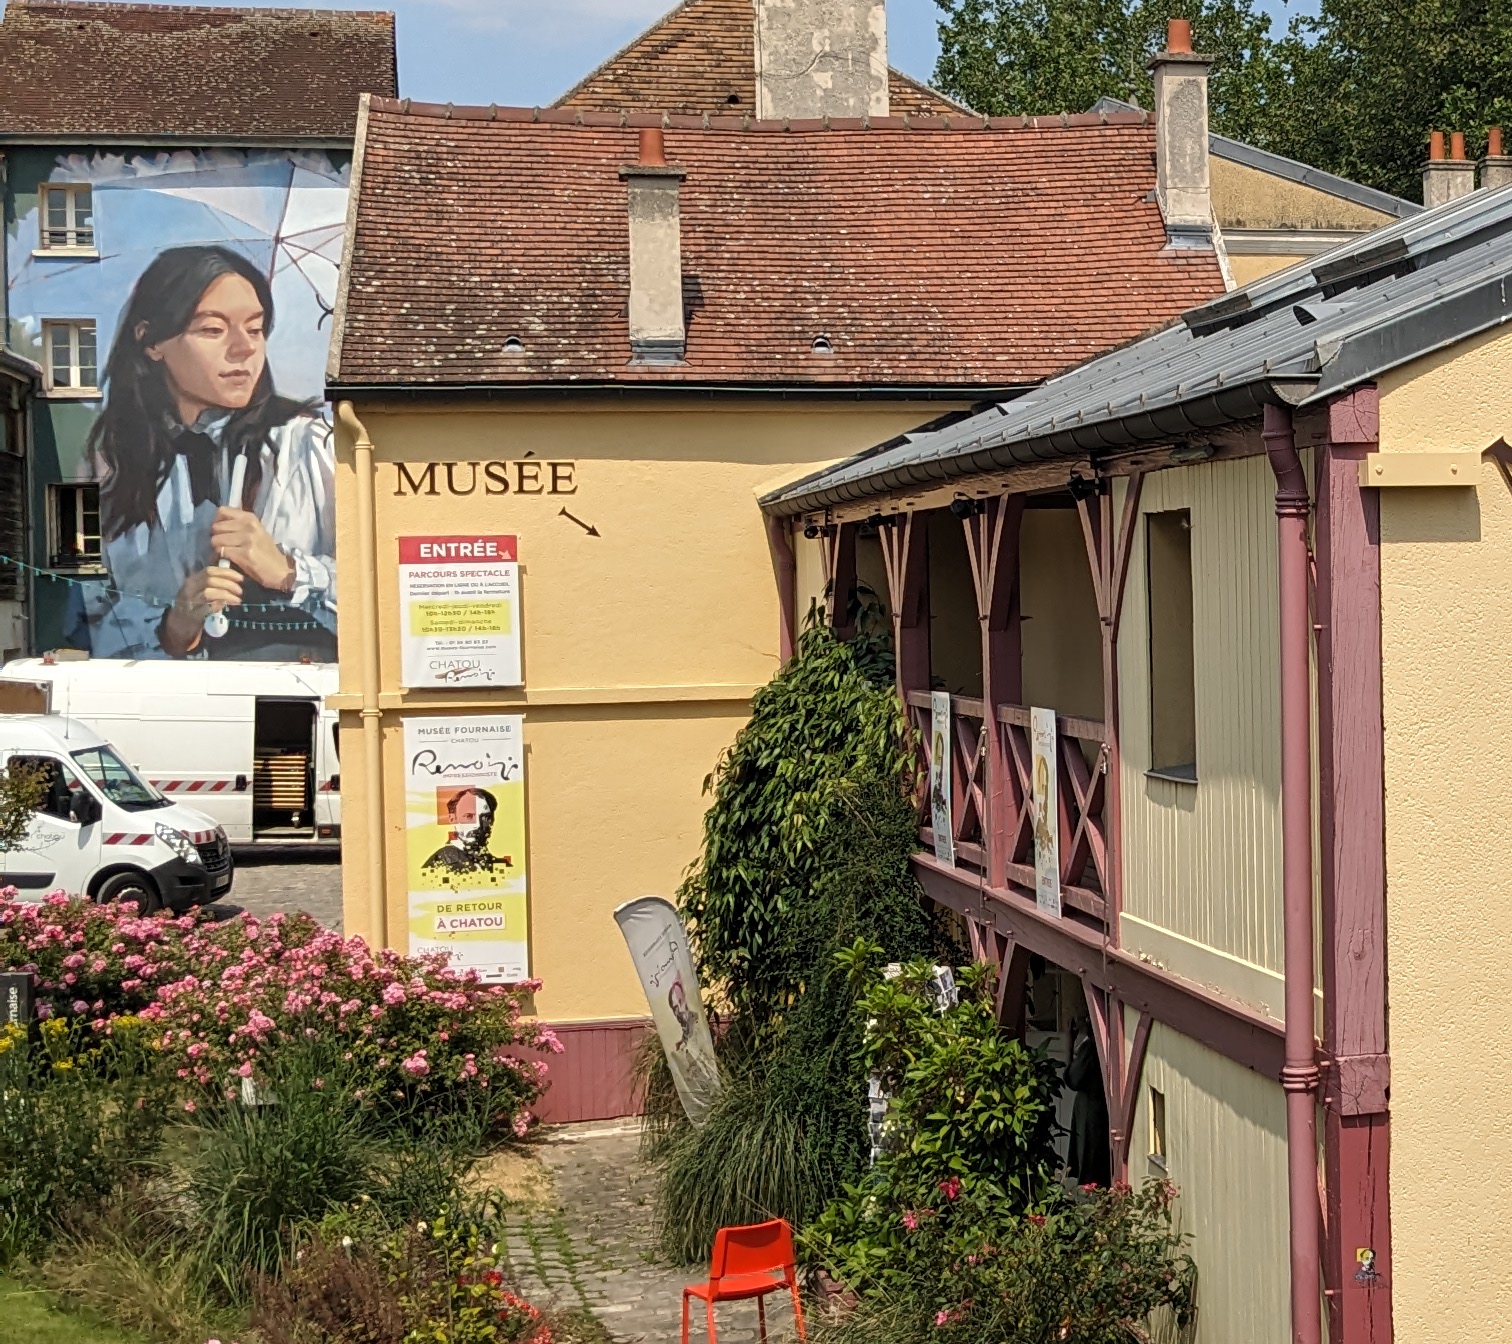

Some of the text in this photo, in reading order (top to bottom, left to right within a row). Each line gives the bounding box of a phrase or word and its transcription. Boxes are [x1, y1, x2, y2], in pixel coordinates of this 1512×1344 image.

[394, 450, 579, 496] MUSÉE
[419, 539, 498, 559] ENTRÉE
[409, 568, 511, 579] PARCOURS SPECTACLE
[429, 659, 481, 670] CHATOU
[418, 724, 512, 735] MUSÉE FOURNAISE
[437, 902, 503, 913] DE RETOUR
[437, 916, 503, 930] À CHATOU
